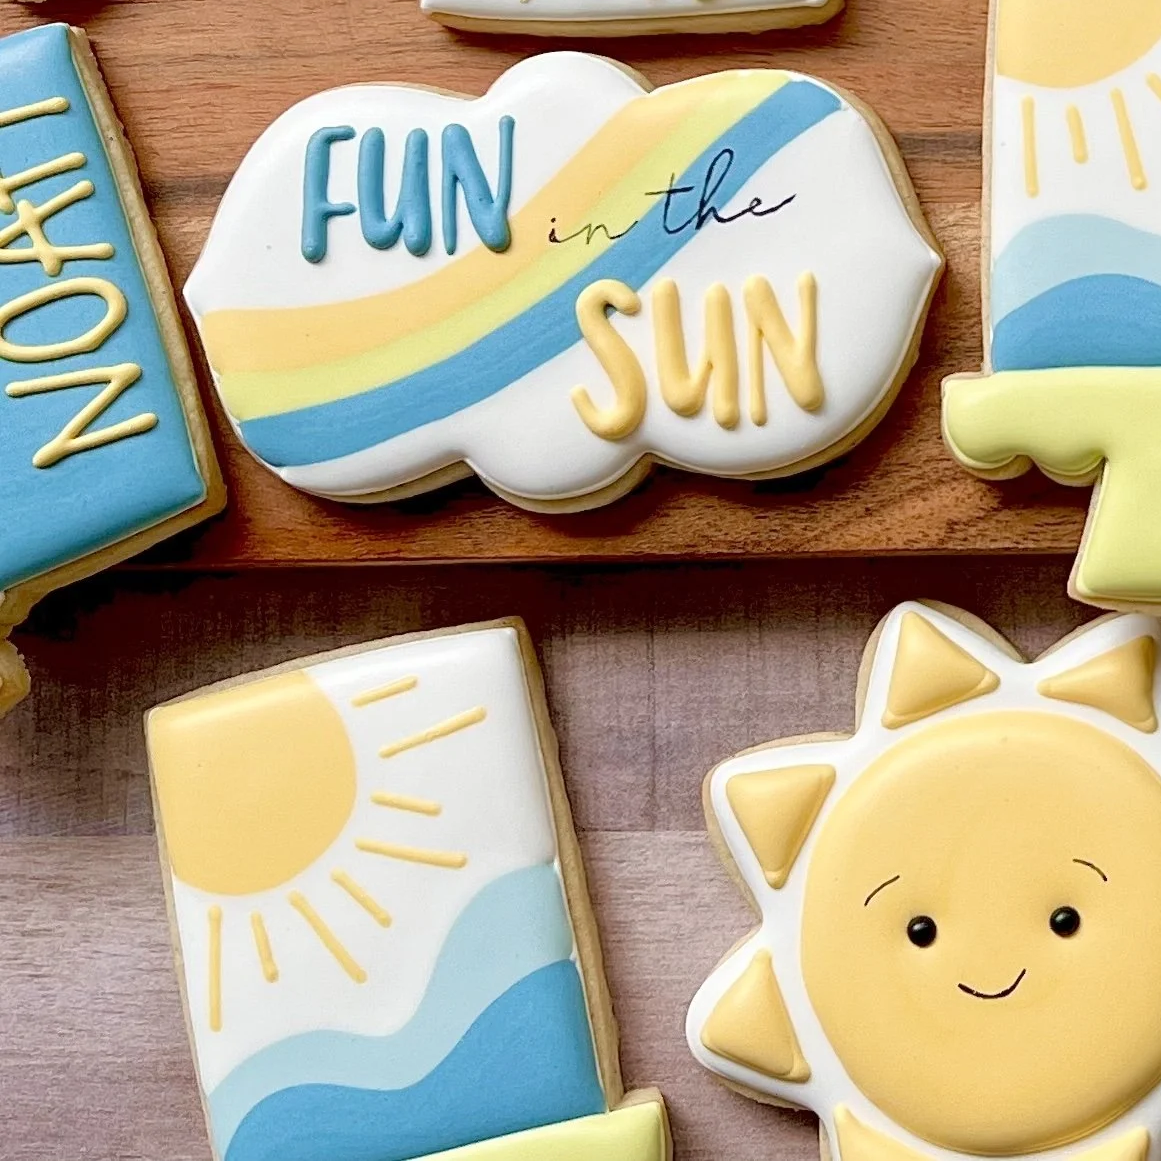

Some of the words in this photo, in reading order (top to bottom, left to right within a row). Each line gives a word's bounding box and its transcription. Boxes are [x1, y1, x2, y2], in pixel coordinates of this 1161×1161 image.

[300, 114, 517, 264] FUN
[547, 216, 639, 245] in
[645, 149, 797, 236] the
[570, 271, 826, 441] SUN
